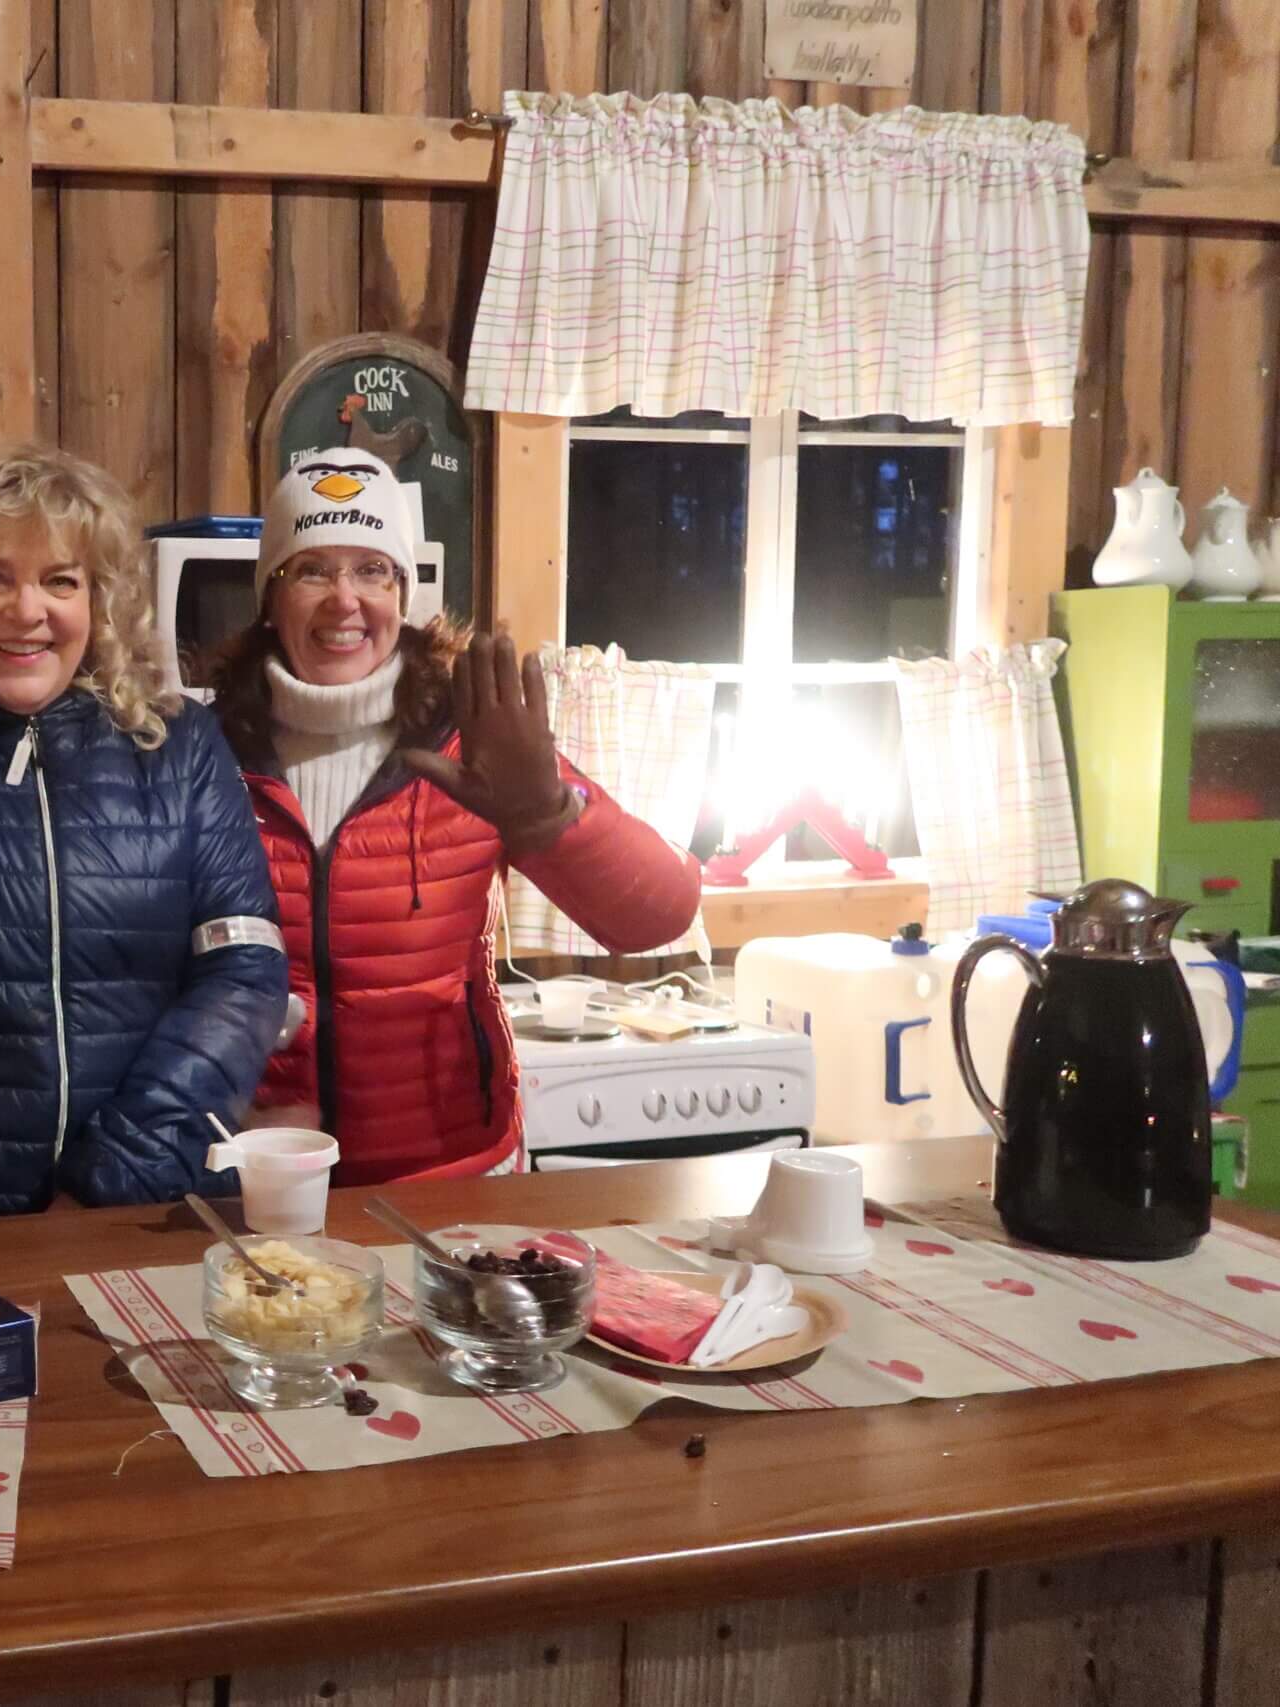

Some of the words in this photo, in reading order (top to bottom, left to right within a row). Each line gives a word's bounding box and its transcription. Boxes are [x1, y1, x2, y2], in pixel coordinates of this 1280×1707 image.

[354, 366, 410, 397] COCK
[367, 392, 393, 412] INN
[430, 452, 458, 472] ALES
